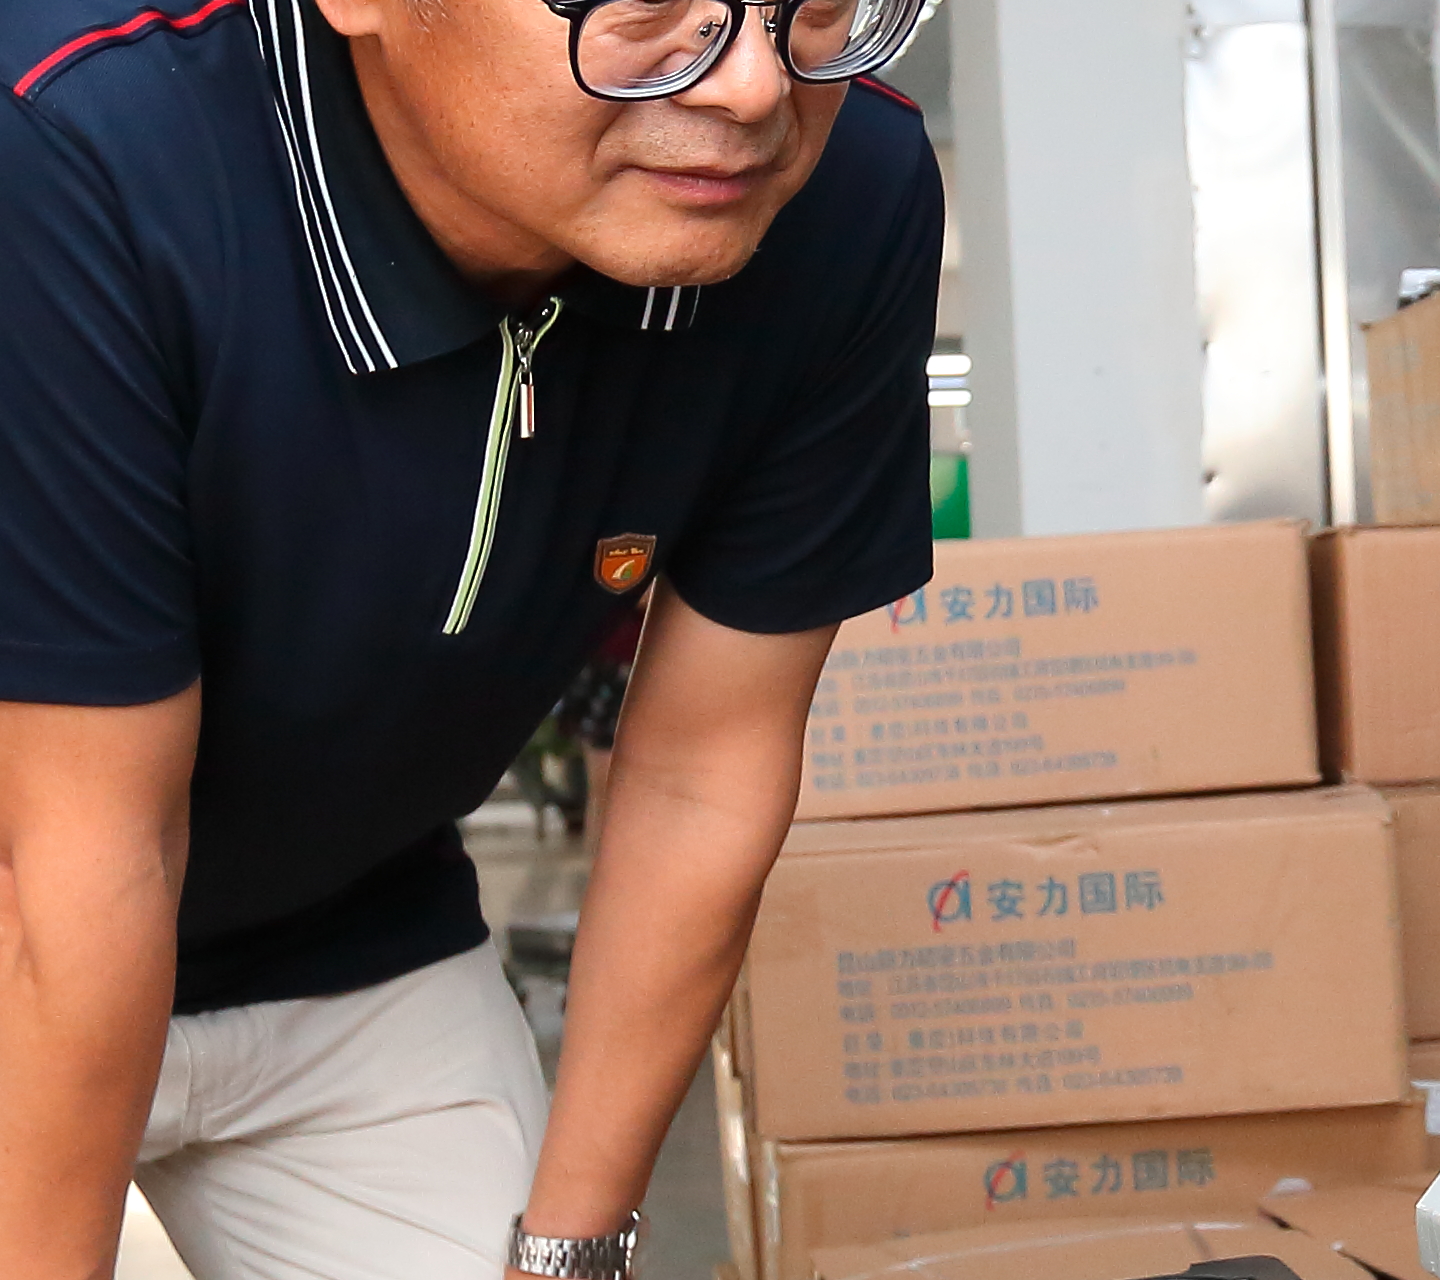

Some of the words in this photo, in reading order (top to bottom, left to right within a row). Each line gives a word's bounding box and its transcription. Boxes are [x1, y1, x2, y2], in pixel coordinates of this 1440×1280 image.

[940, 577, 1099, 625] 安力国际
[986, 869, 1166, 922] 安力国际
[1042, 1147, 1217, 1201] 安力国际
